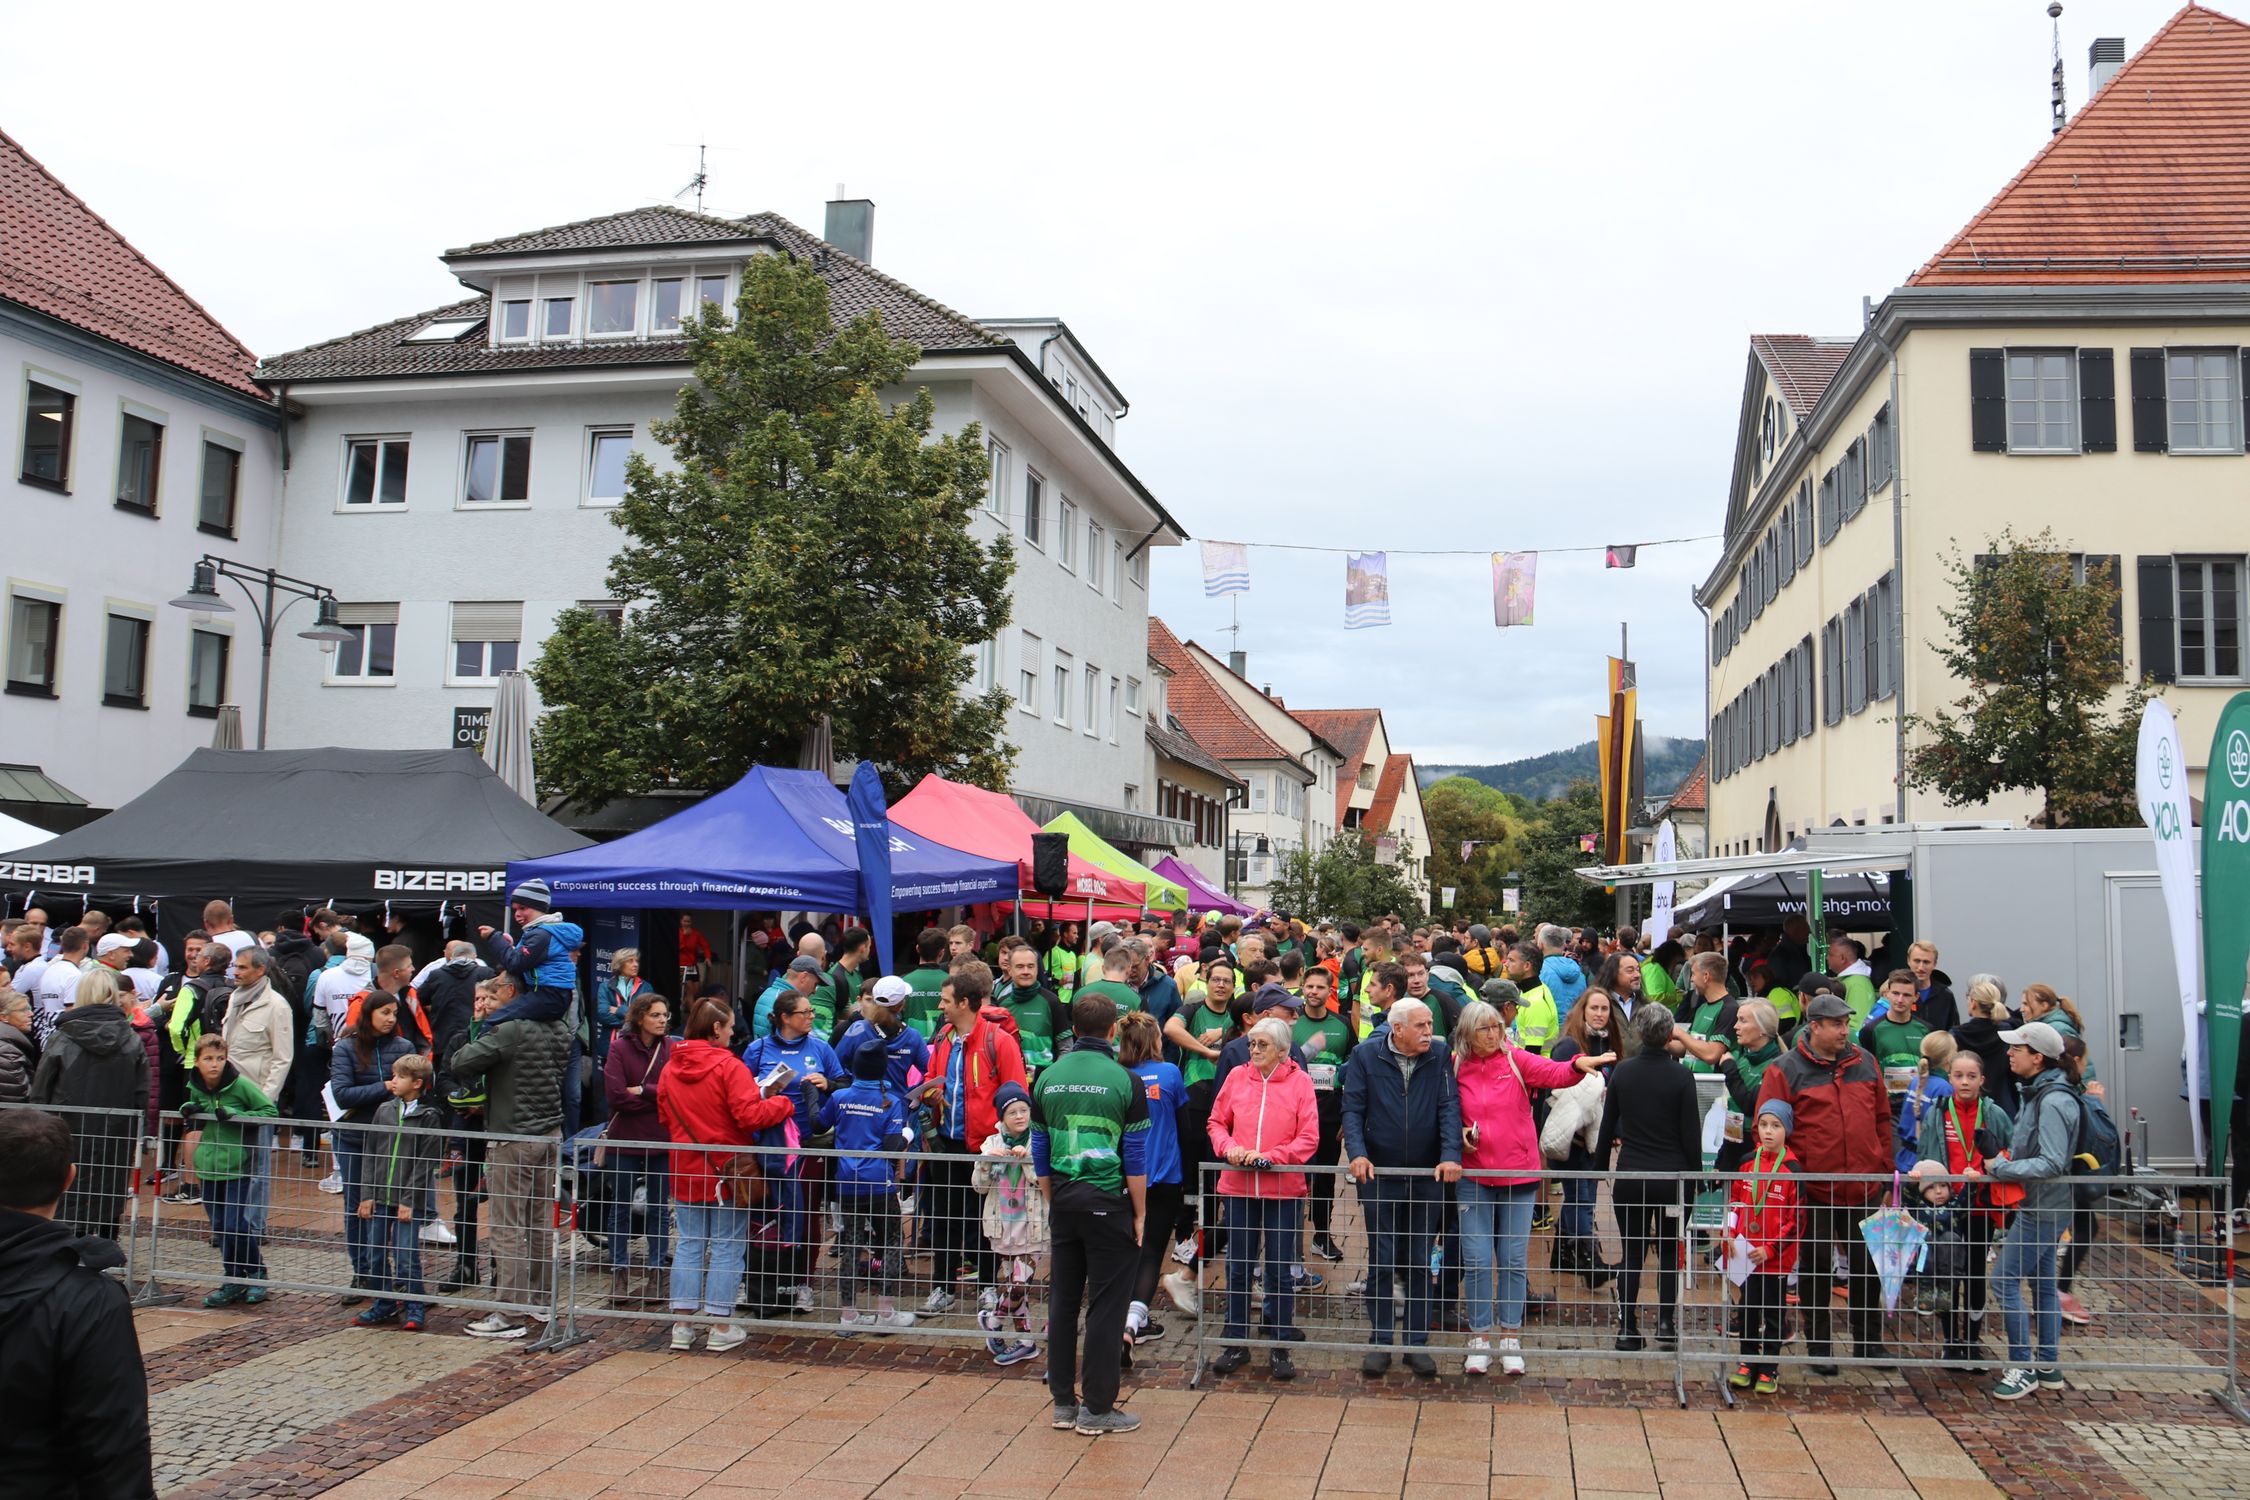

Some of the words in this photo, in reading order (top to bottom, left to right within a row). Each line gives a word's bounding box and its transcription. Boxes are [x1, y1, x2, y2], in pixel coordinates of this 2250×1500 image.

[457, 728, 484, 742] OU
[2217, 799, 2250, 844] AO
[0, 861, 96, 885] ZERBA
[553, 880, 615, 893] Empowering
[617, 881, 657, 891] success
[659, 881, 699, 893] through
[702, 882, 747, 894] financial
[749, 886, 803, 897] expertise.
[890, 883, 922, 900] Empowering
[922, 884, 941, 895] success
[941, 881, 959, 895] through
[959, 879, 978, 891] financial
[1043, 1084, 1109, 1096] GROZ-BECKERT
[1311, 1077, 1331, 1086] aniel
